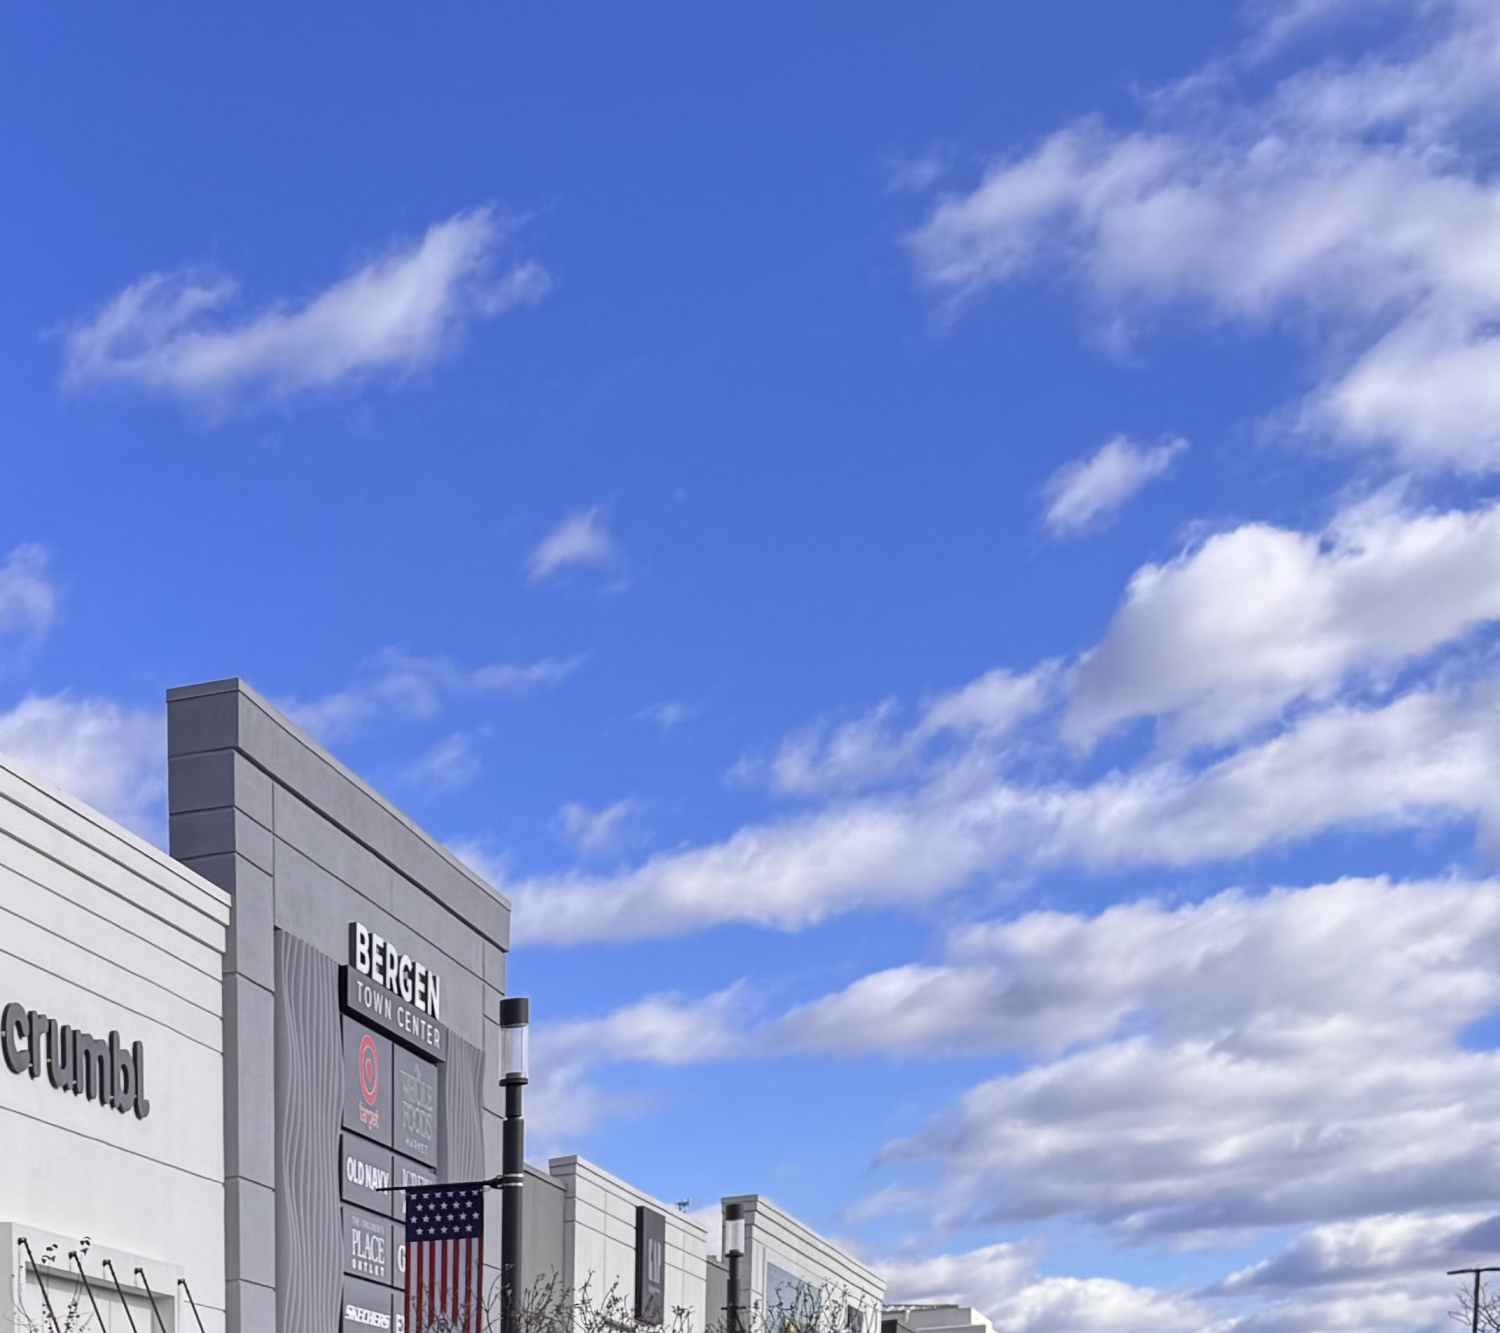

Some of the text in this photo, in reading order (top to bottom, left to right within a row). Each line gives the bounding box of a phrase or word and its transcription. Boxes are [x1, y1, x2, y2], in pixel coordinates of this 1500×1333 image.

[355, 921, 440, 1020] BERGEN
[357, 980, 441, 1048] TOWN CENTER
[0, 1002, 150, 1120] crumbl
[347, 1156, 365, 1186] OLD
[365, 1163, 390, 1195] NAVY
[352, 1228, 385, 1265] PLACE
[352, 1258, 385, 1277] OUTLET
[344, 1304, 391, 1330] SKECHERS
